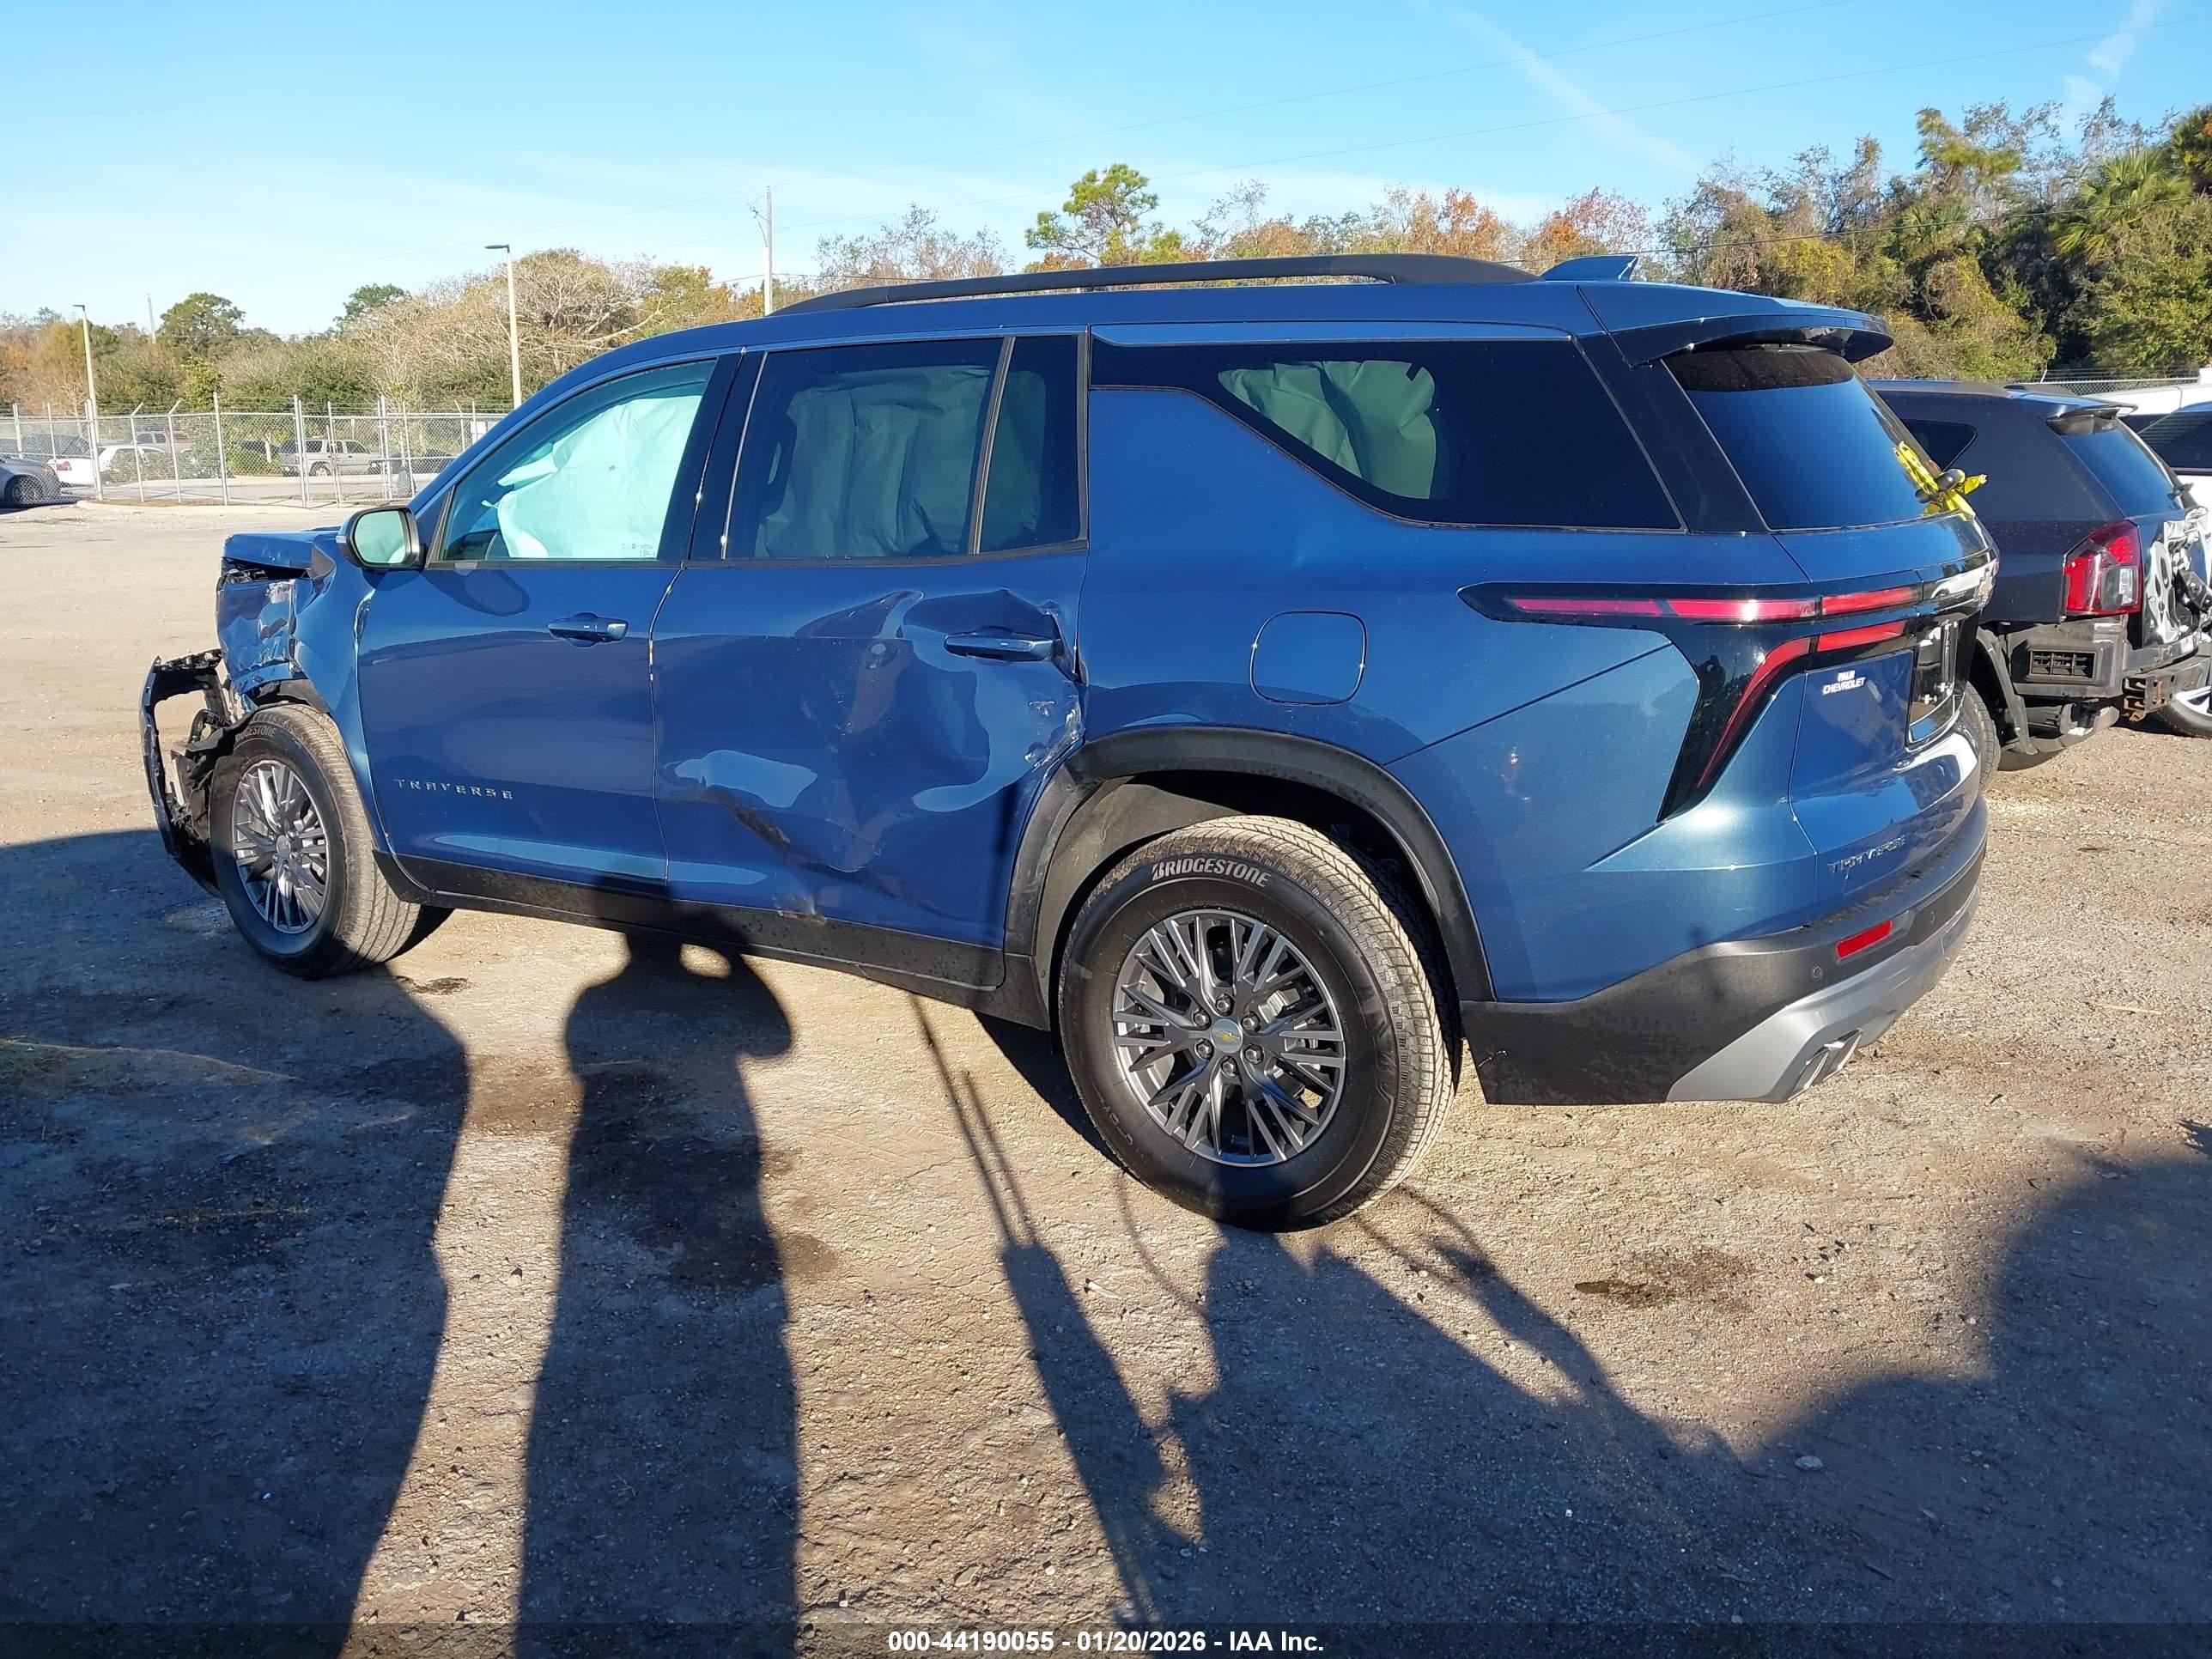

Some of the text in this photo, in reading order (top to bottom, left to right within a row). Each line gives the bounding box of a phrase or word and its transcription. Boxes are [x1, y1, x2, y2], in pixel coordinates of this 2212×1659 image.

[1822, 677, 1867, 695] CHEVROLET
[392, 779, 514, 799] TRAVERSE
[1152, 858, 1272, 888] BRIDGESTONE
